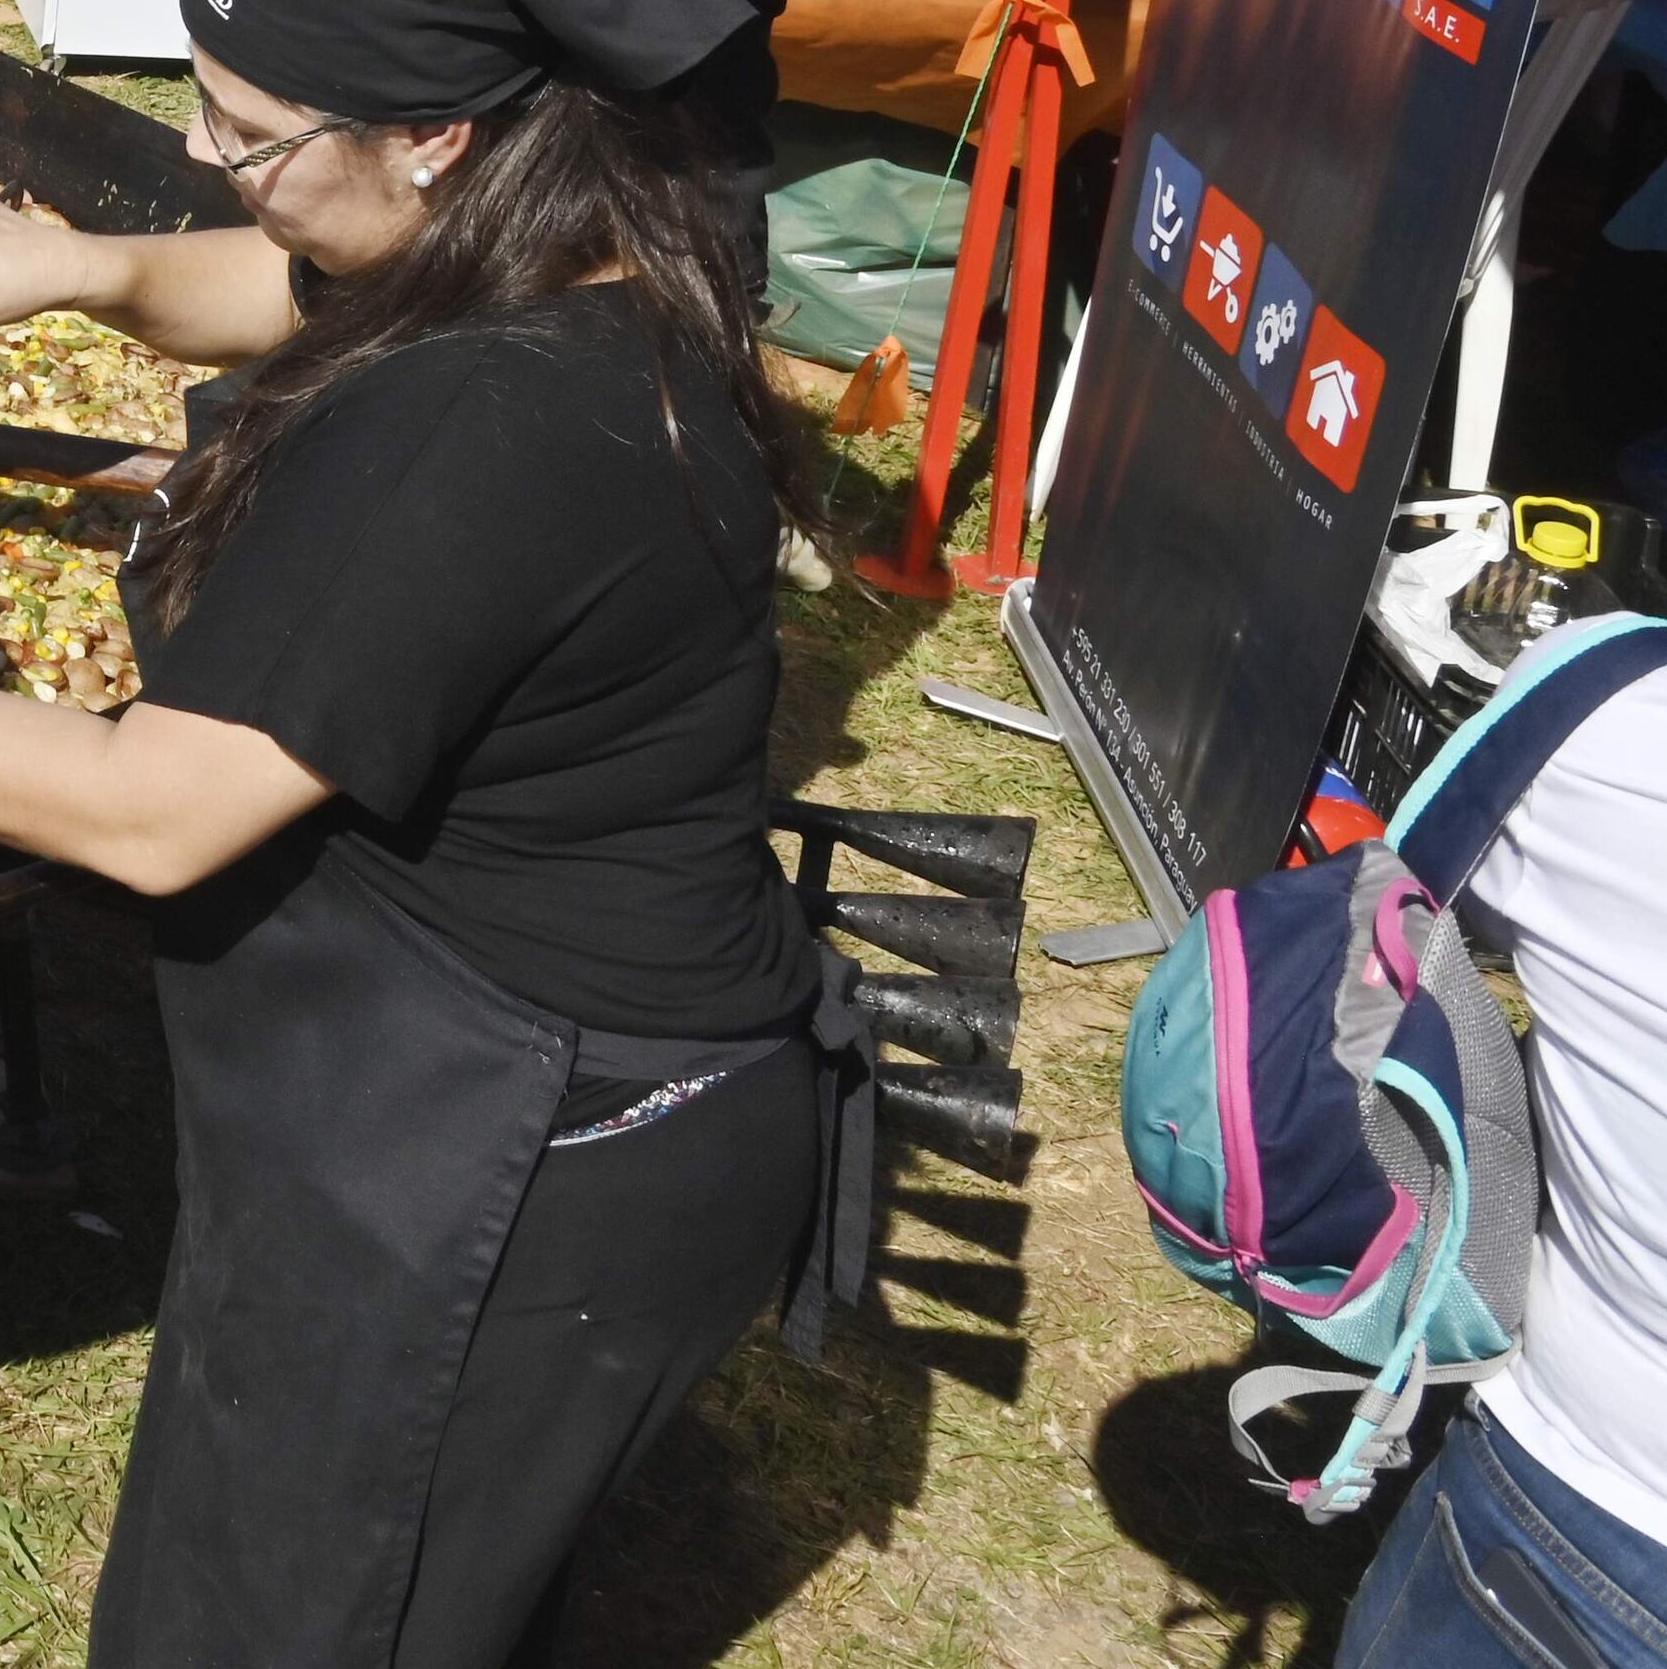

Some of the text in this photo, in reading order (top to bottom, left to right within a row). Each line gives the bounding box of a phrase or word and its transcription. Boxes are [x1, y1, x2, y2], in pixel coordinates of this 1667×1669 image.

[1182, 338, 1239, 414] HERRAMIENTAS
[1245, 419, 1285, 481] INDUSTRIA
[1295, 488, 1334, 531] HOGAR
[1062, 649, 1075, 676] Av.
[1075, 669, 1096, 717] Perón
[1107, 728, 1121, 764] 134
[1123, 765, 1159, 848] Asunción,
[1160, 838, 1198, 916] Paraguay
[1100, 676, 1115, 707] 331
[1116, 697, 1131, 734] 230
[1133, 733, 1150, 770] 301
[1149, 762, 1166, 799] 551
[1168, 800, 1187, 840] 308
[1189, 832, 1207, 868] 117
